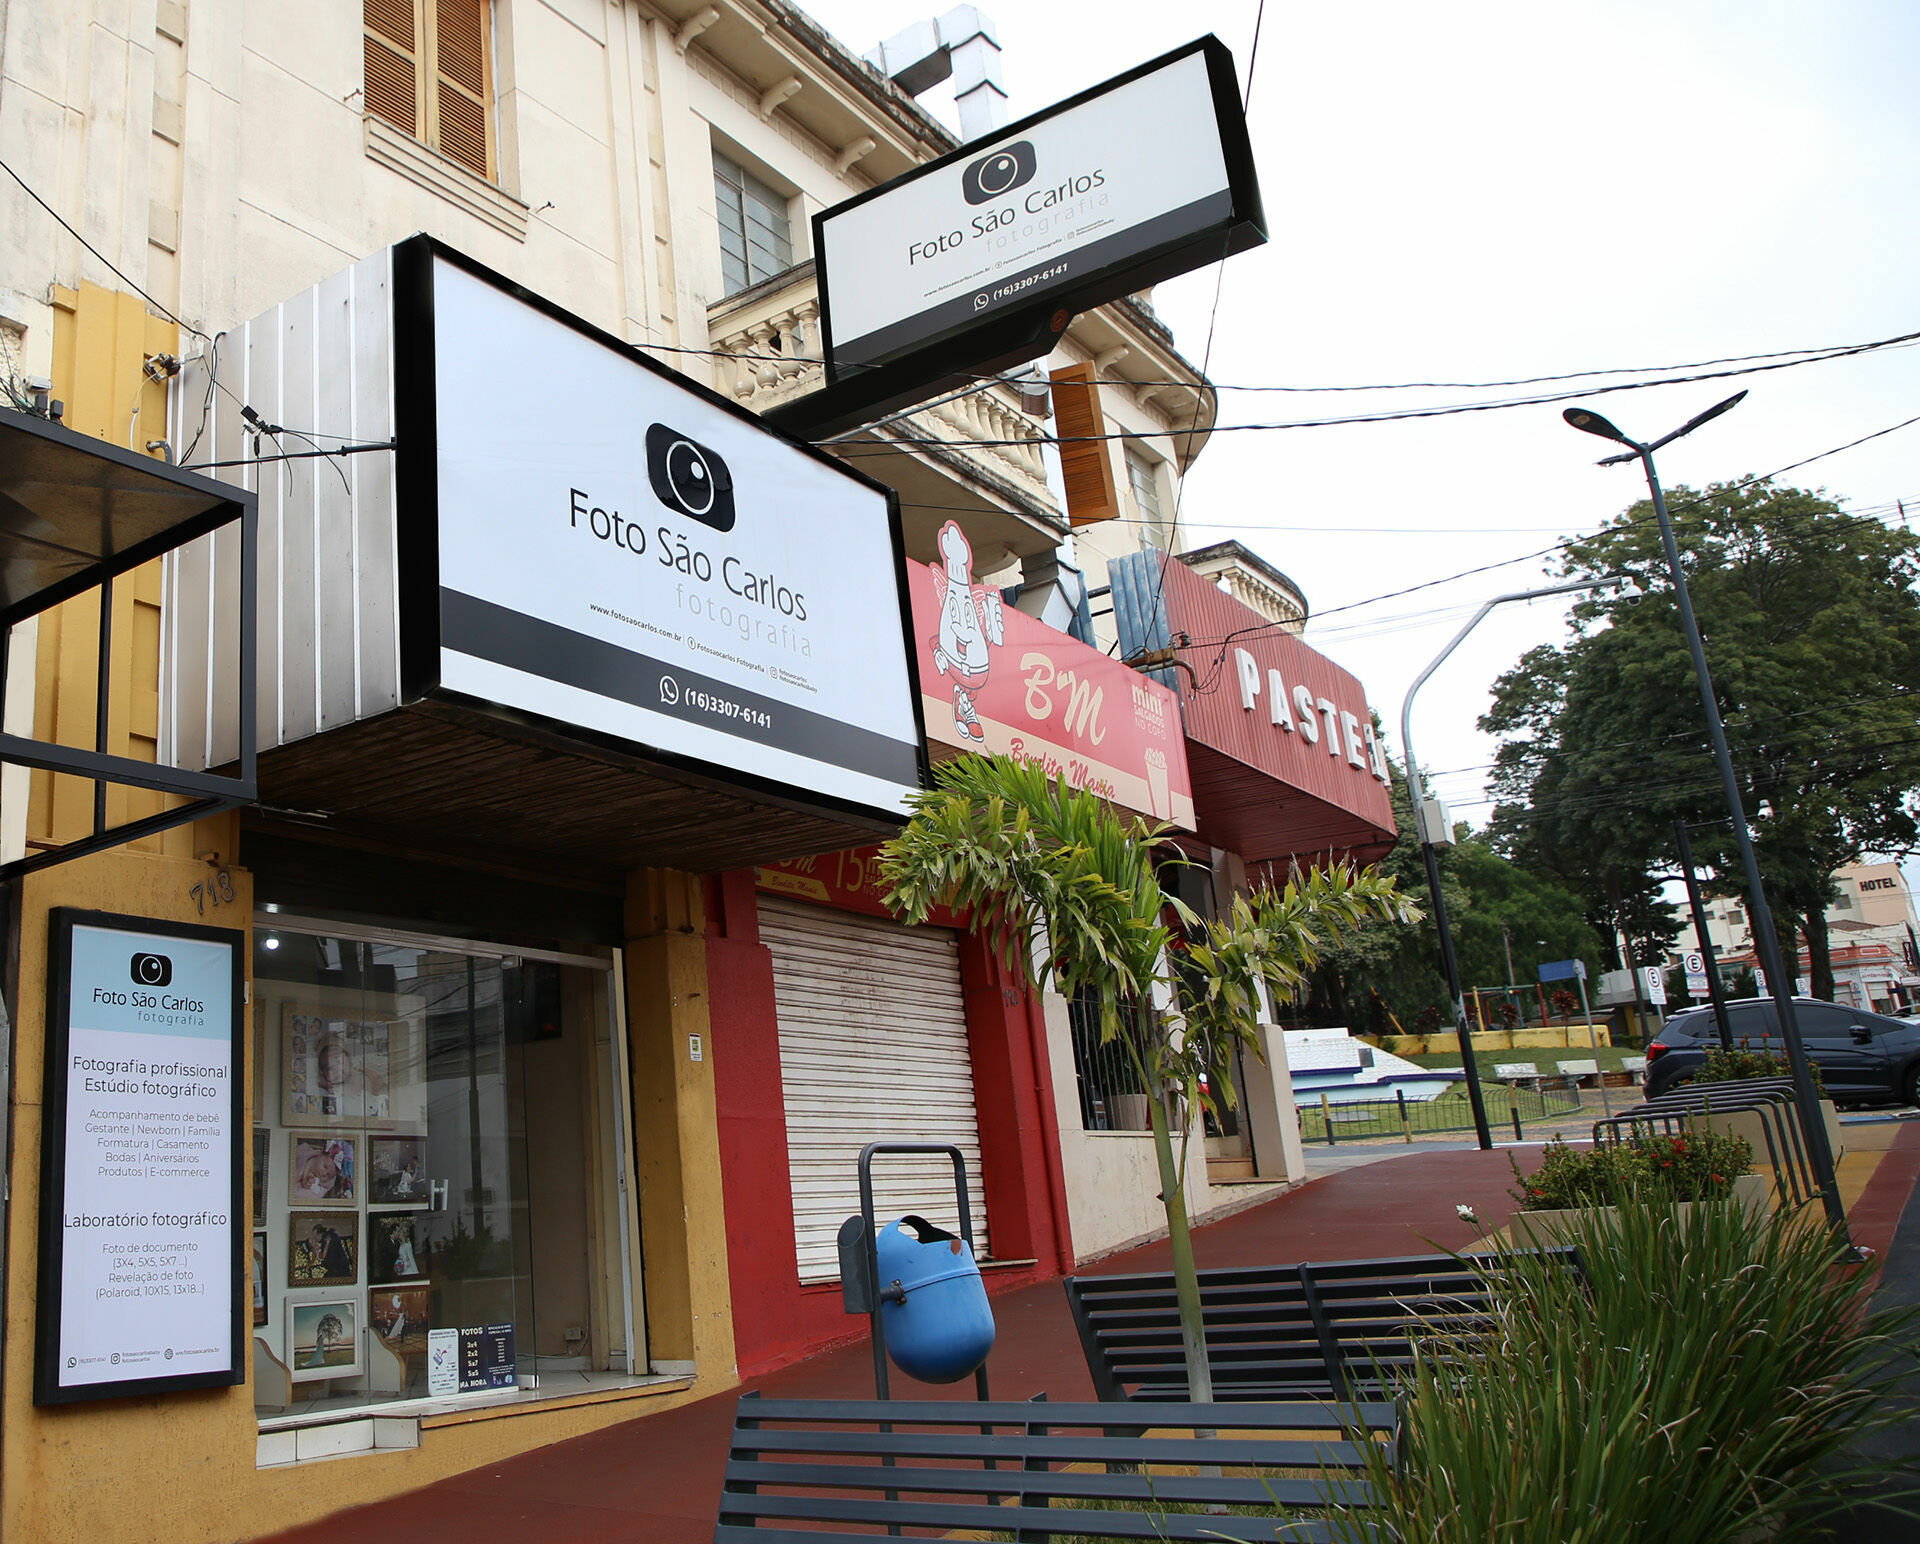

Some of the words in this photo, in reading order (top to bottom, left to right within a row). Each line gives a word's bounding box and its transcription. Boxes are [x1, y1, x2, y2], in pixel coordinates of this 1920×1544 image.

[909, 231, 963, 266] Foto
[971, 207, 1016, 238] São
[1024, 167, 1106, 213] Carlos
[985, 193, 1108, 253] fotografia
[993, 262, 1069, 301] (16)3307-6141
[569, 487, 647, 555] Foto
[657, 526, 712, 582] São
[722, 556, 808, 622] Carlos
[589, 602, 682, 642] www.fotosaocarlos.com.br
[675, 582, 812, 658] fotografia
[685, 687, 772, 729] (16)3307-6141
[1131, 684, 1163, 717] mini
[1135, 717, 1146, 730] NO
[836, 848, 864, 892] 15
[1859, 877, 1896, 892] HOTEL
[1691, 958, 1698, 969] E
[1651, 972, 1658, 984] E
[93, 988, 127, 1006] Foto
[131, 991, 157, 1009] São
[161, 995, 204, 1013] Carlos
[138, 1010, 204, 1026] fotografia
[73, 1056, 147, 1075] Fotografia
[151, 1062, 227, 1079] profissional
[85, 1078, 139, 1095] Estúdio
[142, 1080, 216, 1098] fotográfico
[89, 1109, 181, 1123] Acompanhamento
[182, 1111, 195, 1123] de
[85, 1123, 130, 1135] Gestante
[137, 1125, 181, 1136] Newborn
[98, 1138, 149, 1149] Formatura
[157, 1139, 210, 1150] Casamento
[105, 1152, 136, 1163] Bodas
[98, 1167, 143, 1177] Produtos
[150, 1167, 210, 1178] E-commerce
[64, 1212, 149, 1229] Laboratório
[151, 1211, 227, 1230] fotográfico
[102, 1244, 125, 1255] Foto
[127, 1243, 140, 1254] de
[142, 1241, 198, 1253] documento
[109, 1271, 159, 1285] Revelação
[160, 1271, 173, 1282] de
[174, 1270, 194, 1281] foto
[461, 1326, 483, 1336] FOTOS
[470, 1379, 488, 1387] HORA
